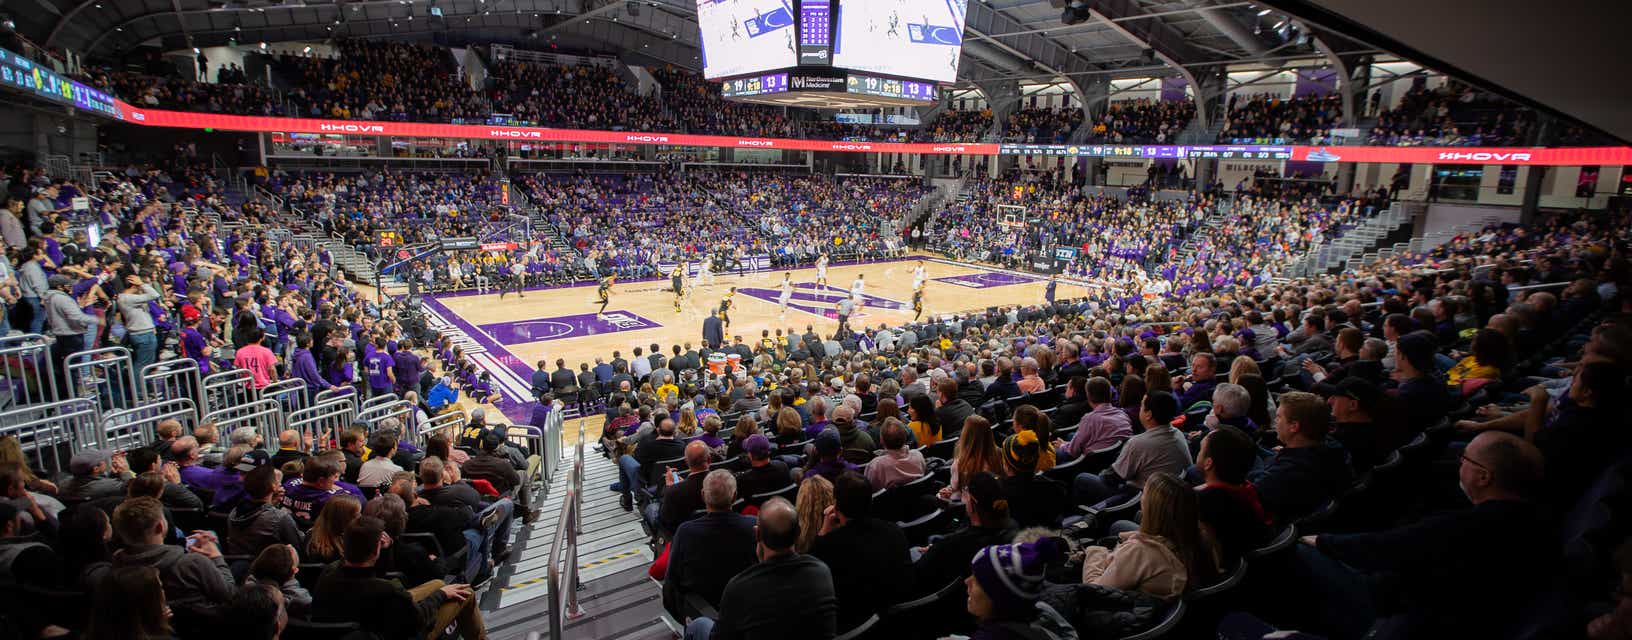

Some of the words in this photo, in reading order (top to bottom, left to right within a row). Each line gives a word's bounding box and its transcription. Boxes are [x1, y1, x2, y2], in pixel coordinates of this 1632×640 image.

[734, 80, 743, 91] 19
[747, 81, 760, 91] 9:18
[766, 76, 775, 88] 13
[865, 78, 877, 89] 19
[883, 83, 901, 94] 9:18
[908, 83, 919, 94] 13
[1114, 147, 1132, 155] 9:18
[1147, 147, 1156, 155] 13
[1177, 147, 1184, 157] N
[750, 257, 758, 270] N
[245, 357, 258, 373] 14
[294, 500, 312, 510] MIKE
